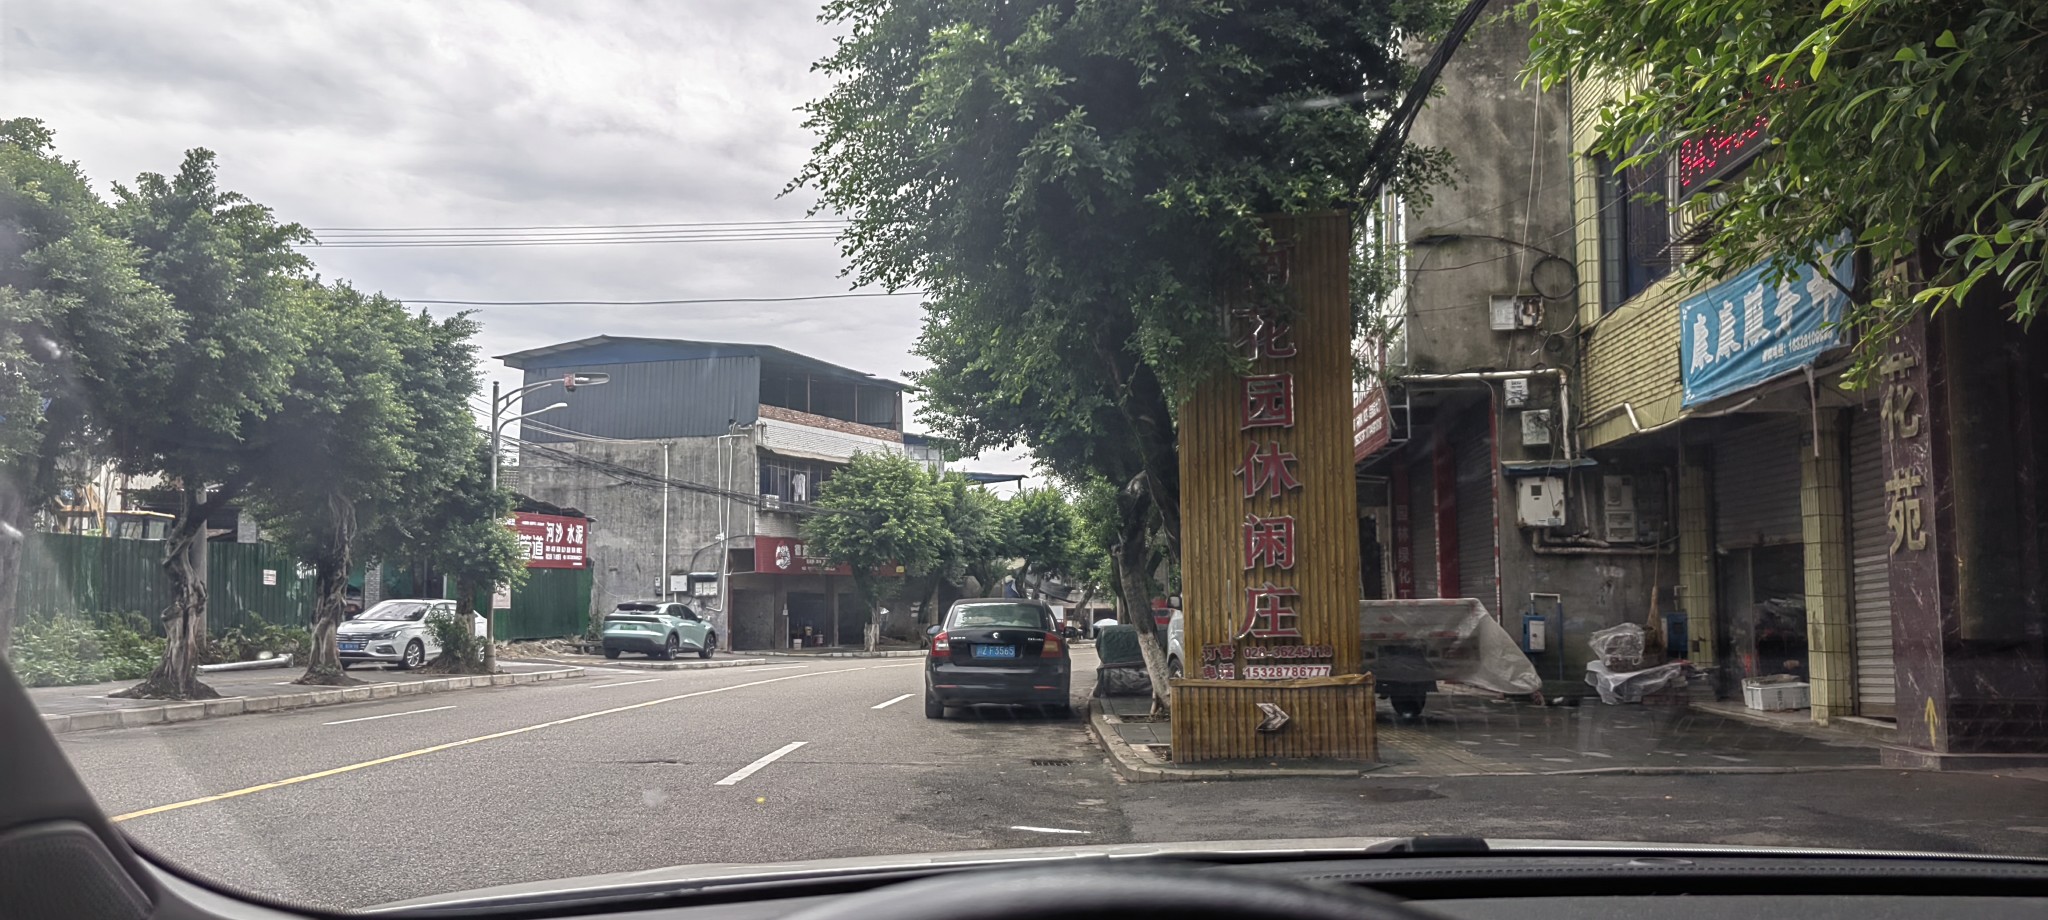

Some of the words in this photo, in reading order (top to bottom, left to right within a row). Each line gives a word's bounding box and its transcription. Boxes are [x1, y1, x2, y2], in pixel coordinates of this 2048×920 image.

[546, 522, 564, 543] 河沙
[567, 524, 584, 544] 水泥
[1202, 663, 1235, 680] 电话
[1243, 664, 1332, 680] 15328786777
